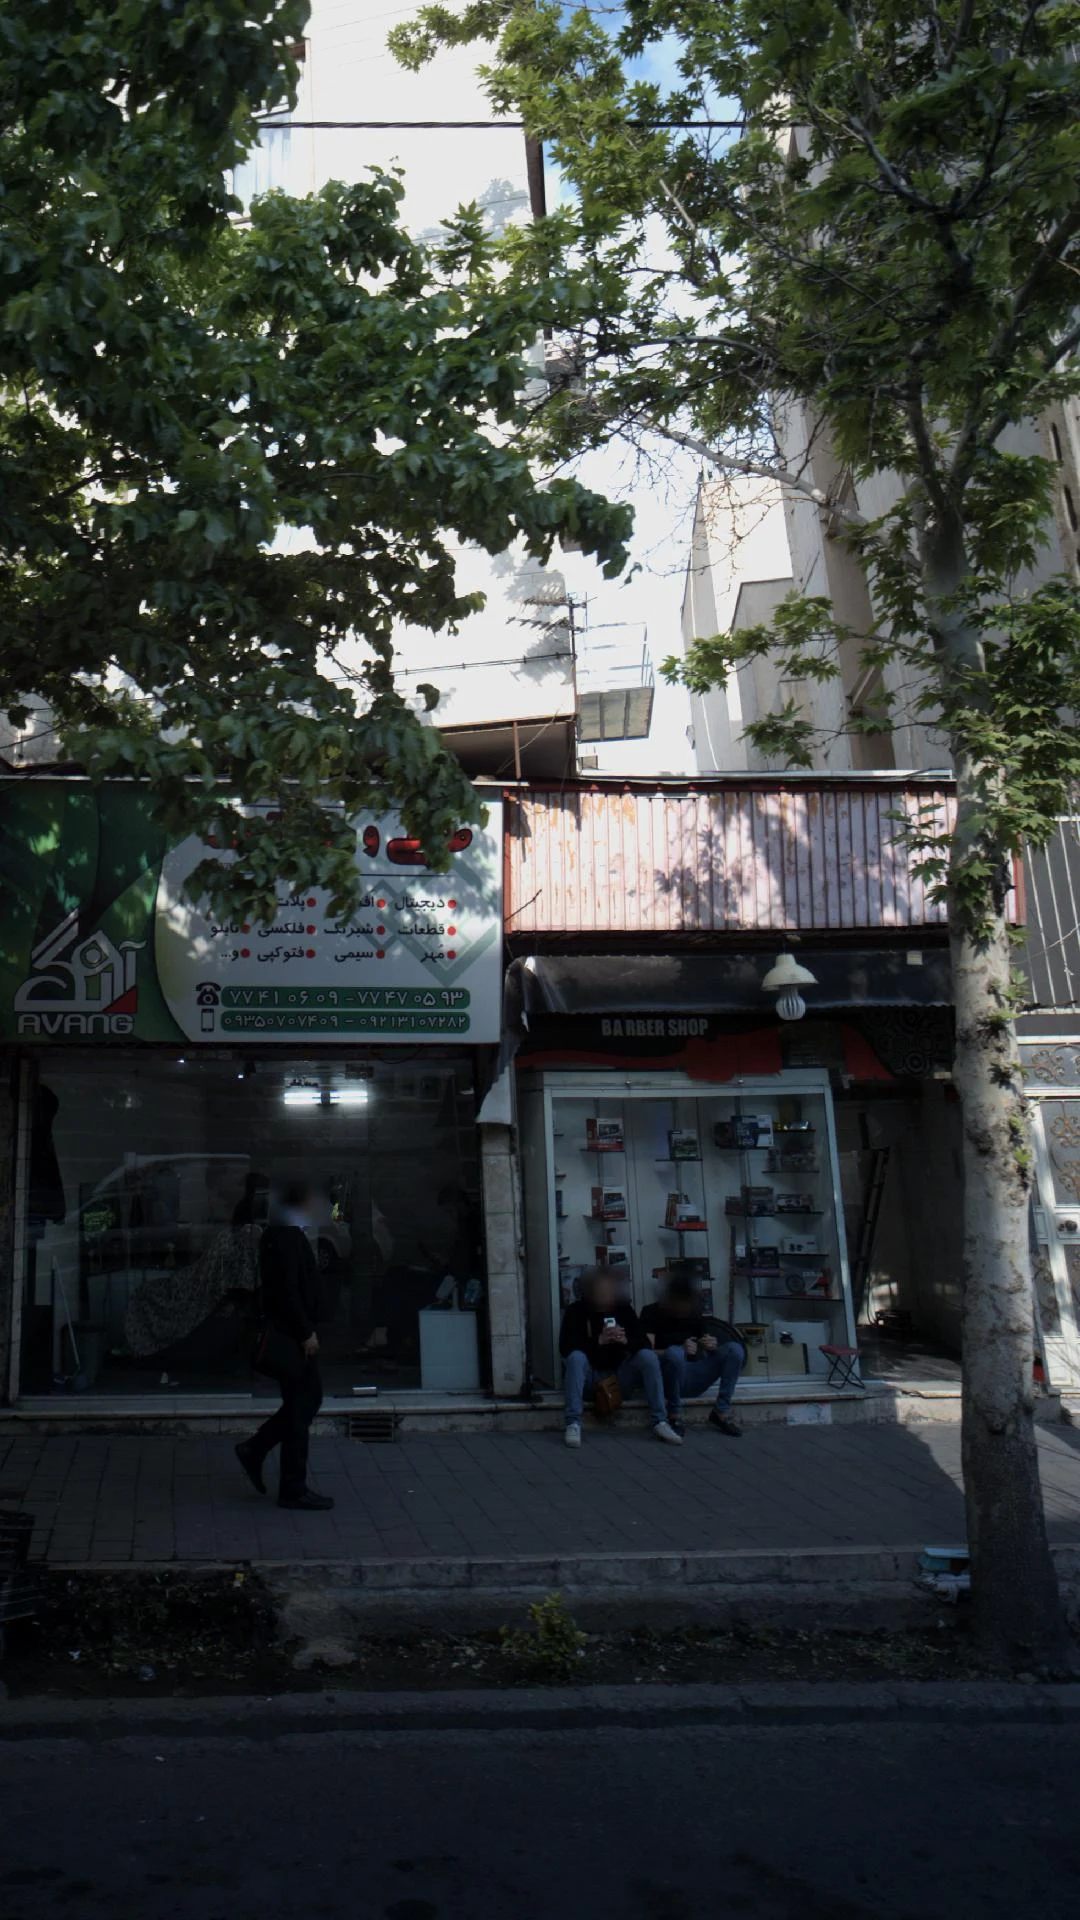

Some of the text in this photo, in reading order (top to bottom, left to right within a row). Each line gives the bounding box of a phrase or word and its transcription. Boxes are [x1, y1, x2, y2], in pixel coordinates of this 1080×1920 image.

[394, 896, 445, 911] دیجیتال
[257, 922, 305, 938] فلکسی
[397, 923, 445, 936] قطعات
[256, 945, 305, 963] فتوکپی
[334, 948, 374, 962] سیمی
[17, 1013, 135, 1035] AVANG
[601, 1018, 709, 1037] BARBER SHOP
